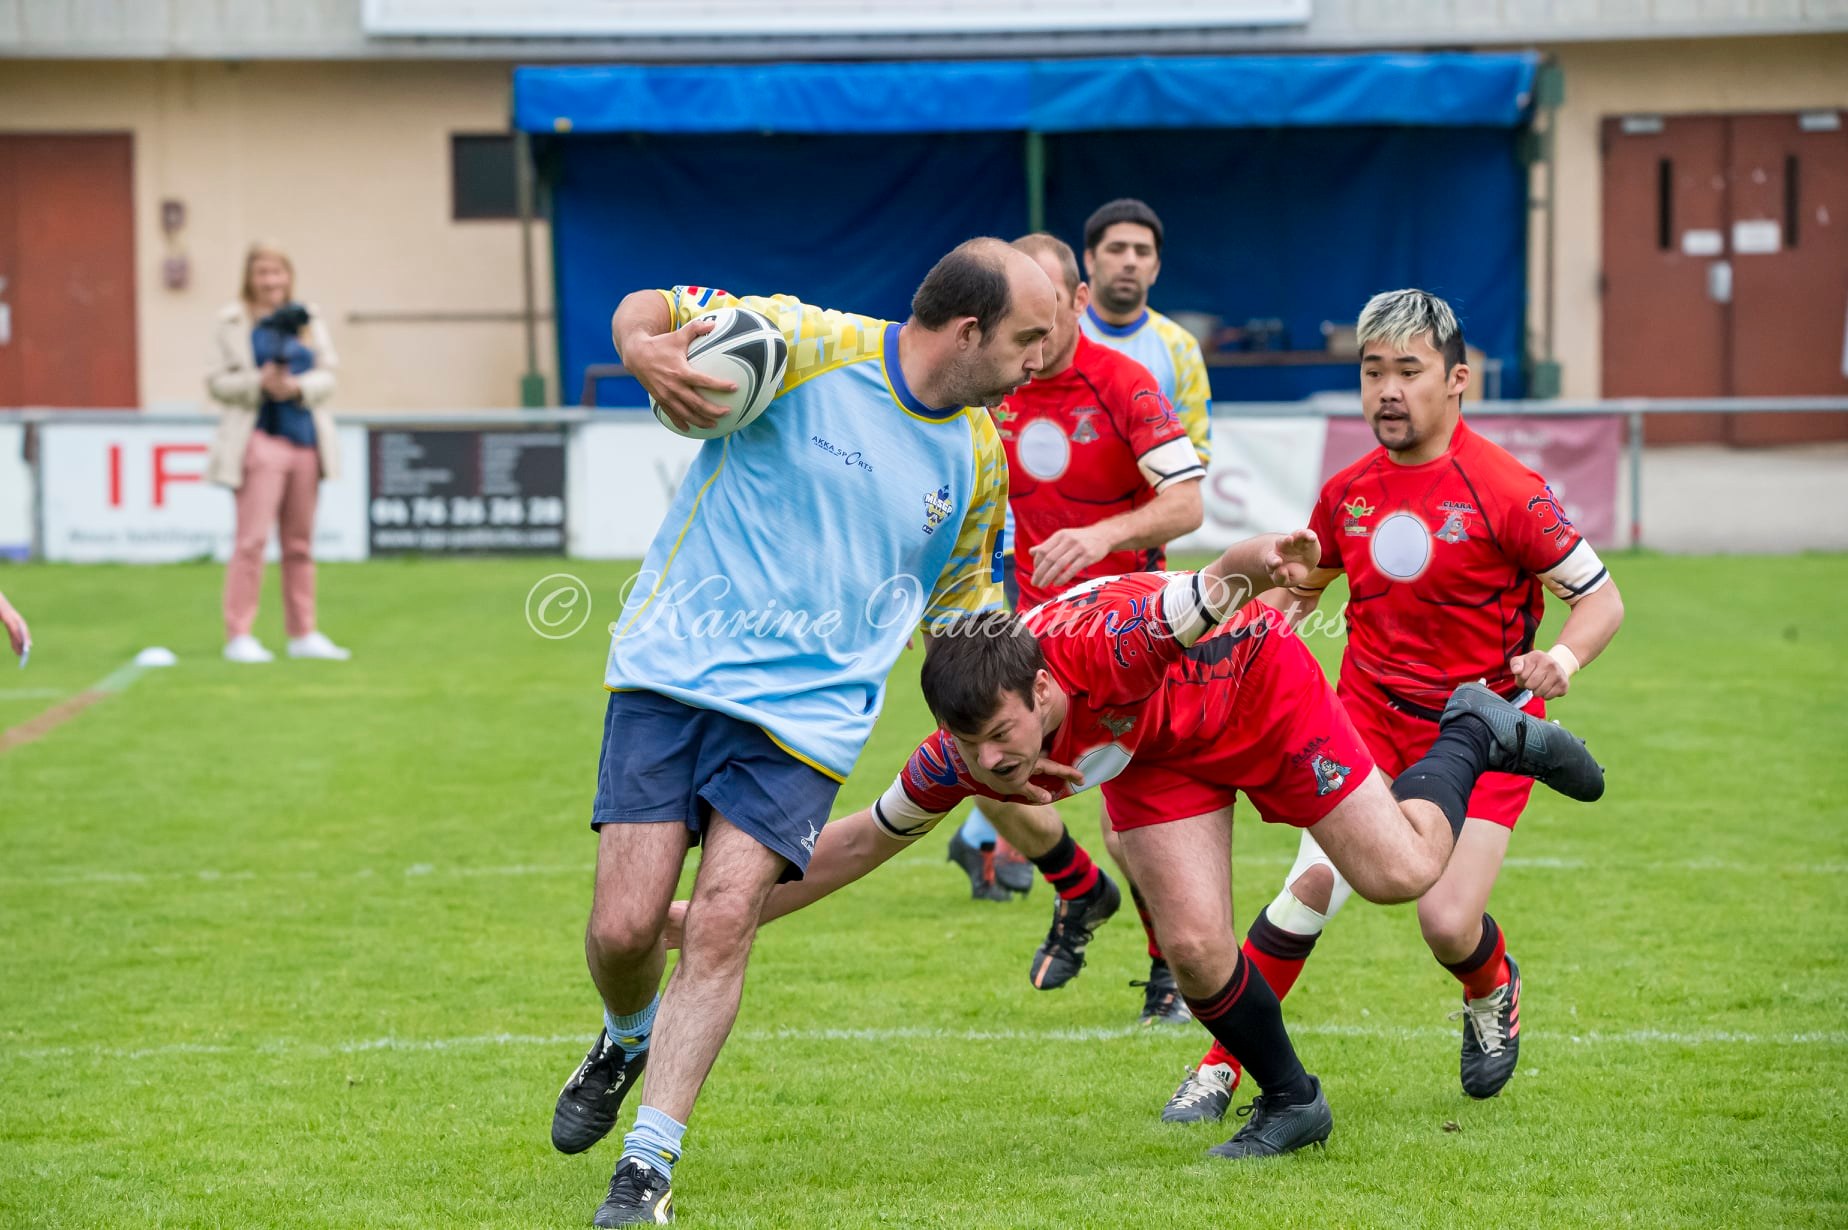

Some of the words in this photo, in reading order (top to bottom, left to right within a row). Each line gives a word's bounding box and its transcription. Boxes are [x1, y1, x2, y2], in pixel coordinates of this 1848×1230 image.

[811, 435, 835, 452] AKKA
[836, 448, 874, 473] SPORTS
[1443, 501, 1473, 510] CLARA
